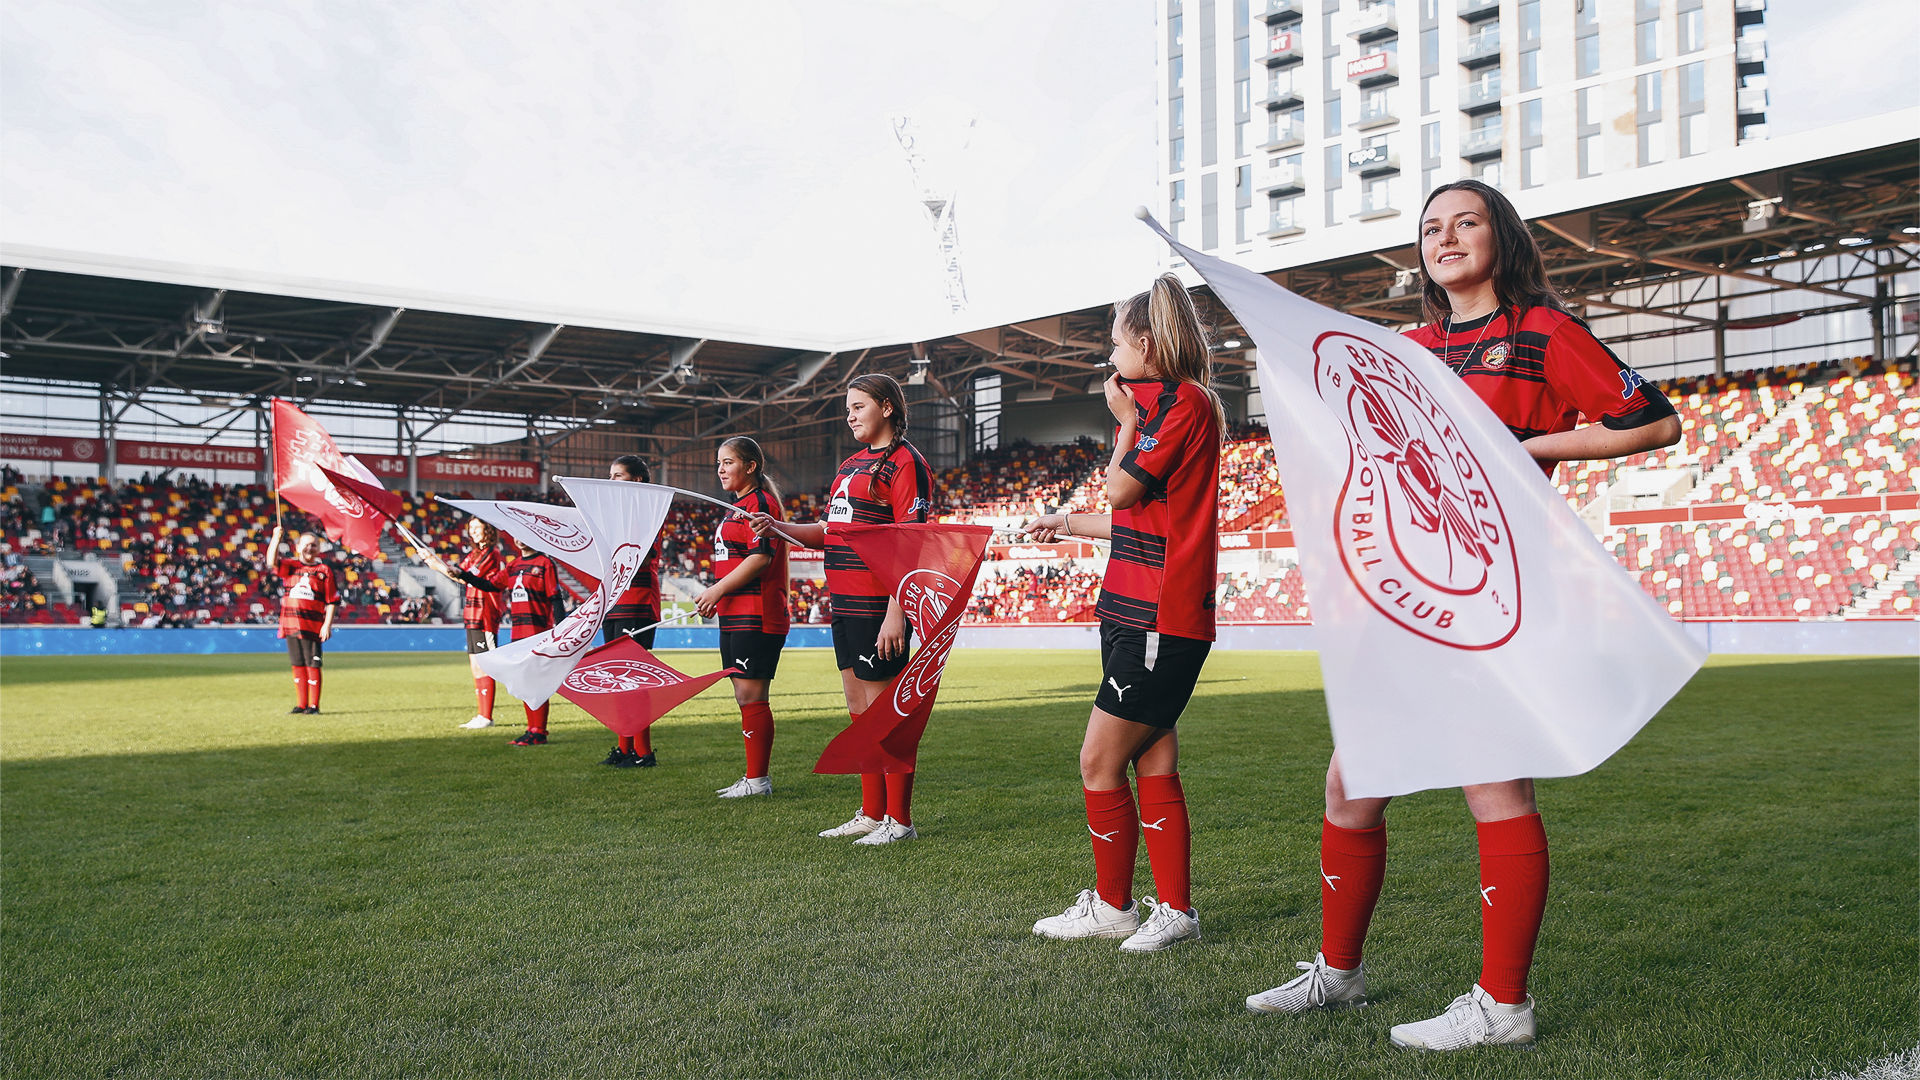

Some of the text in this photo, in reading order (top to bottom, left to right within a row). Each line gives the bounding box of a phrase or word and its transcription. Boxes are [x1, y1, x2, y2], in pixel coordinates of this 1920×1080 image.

[1345, 345, 1499, 545] BRENTFORD
[435, 462, 534, 478] BEETOGETHER
[830, 503, 848, 515] Titan
[789, 550, 813, 559] ONDON
[1379, 578, 1455, 629] CLUB
[901, 676, 916, 703] CLUB
